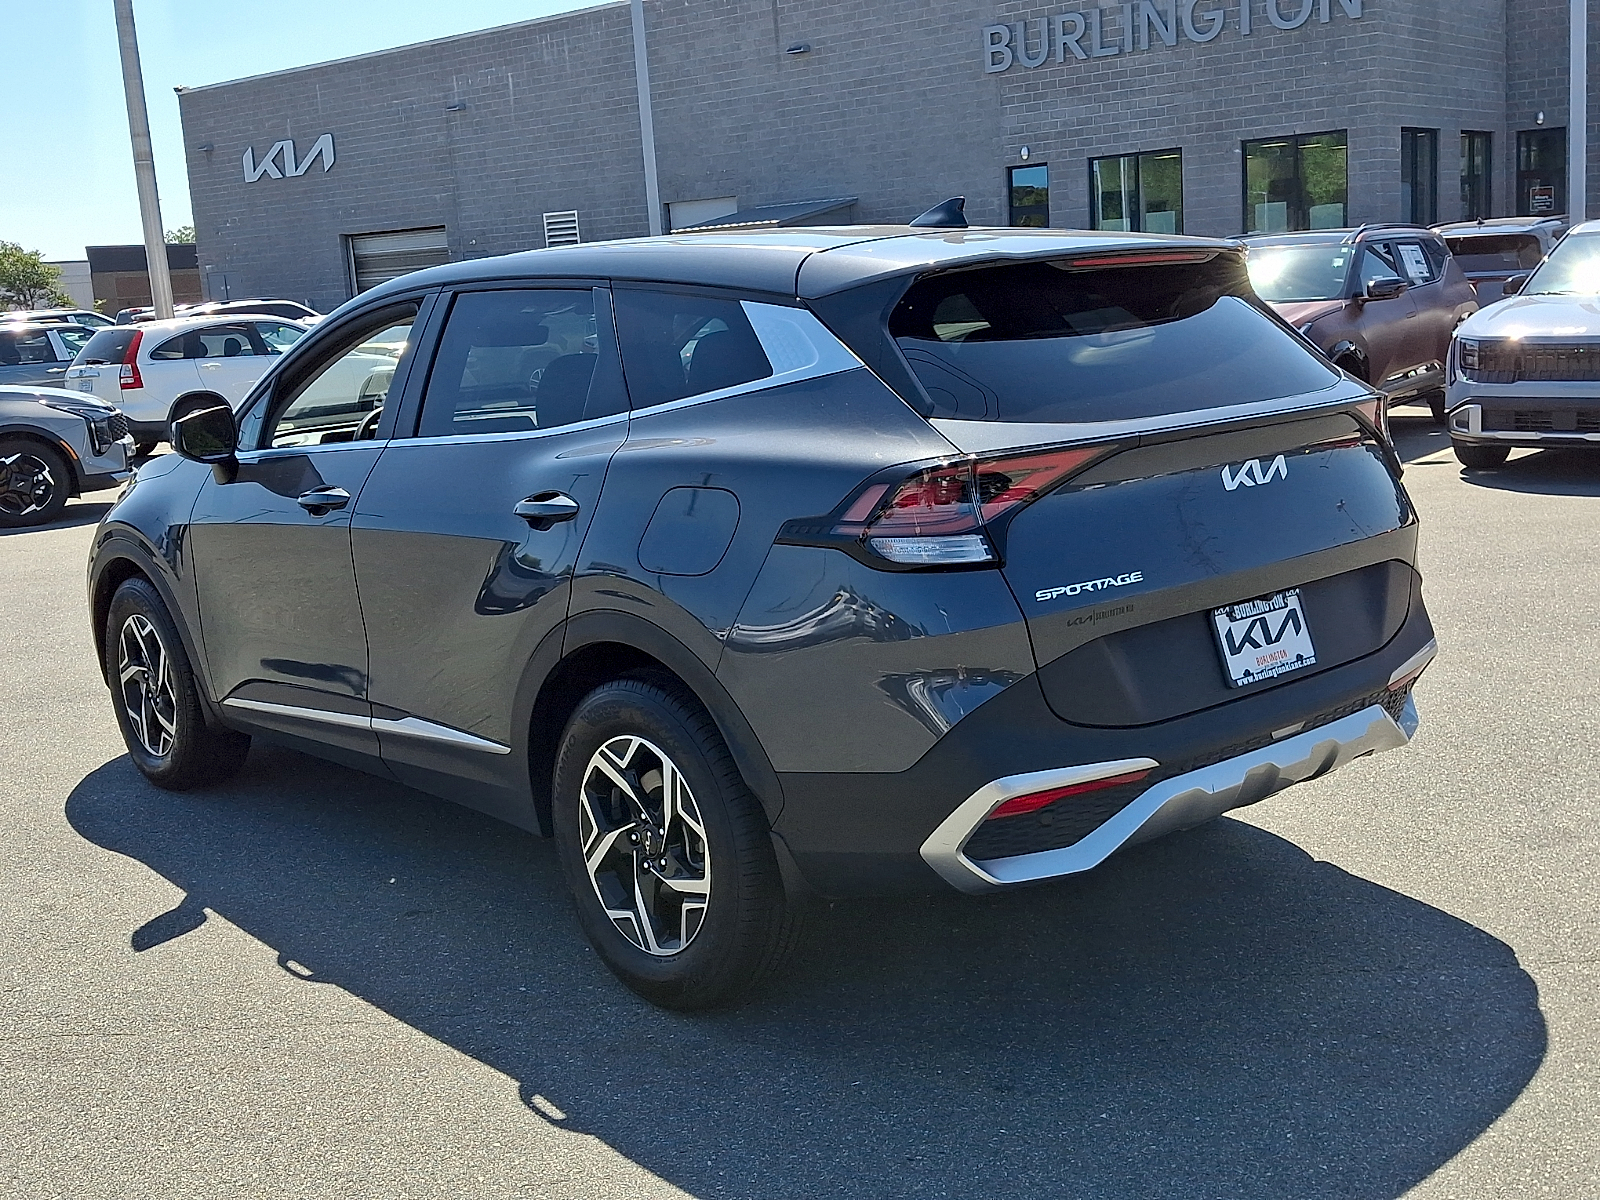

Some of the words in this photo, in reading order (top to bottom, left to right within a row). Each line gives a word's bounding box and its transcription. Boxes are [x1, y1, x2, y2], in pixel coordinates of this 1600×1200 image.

[243, 133, 334, 183] KIA
[1221, 454, 1288, 491] KIA
[1035, 571, 1144, 602] SPORTAGE
[1235, 595, 1284, 619] BURLINGTON
[1225, 608, 1301, 656] KIA
[1256, 649, 1288, 666] BURLINGTON
